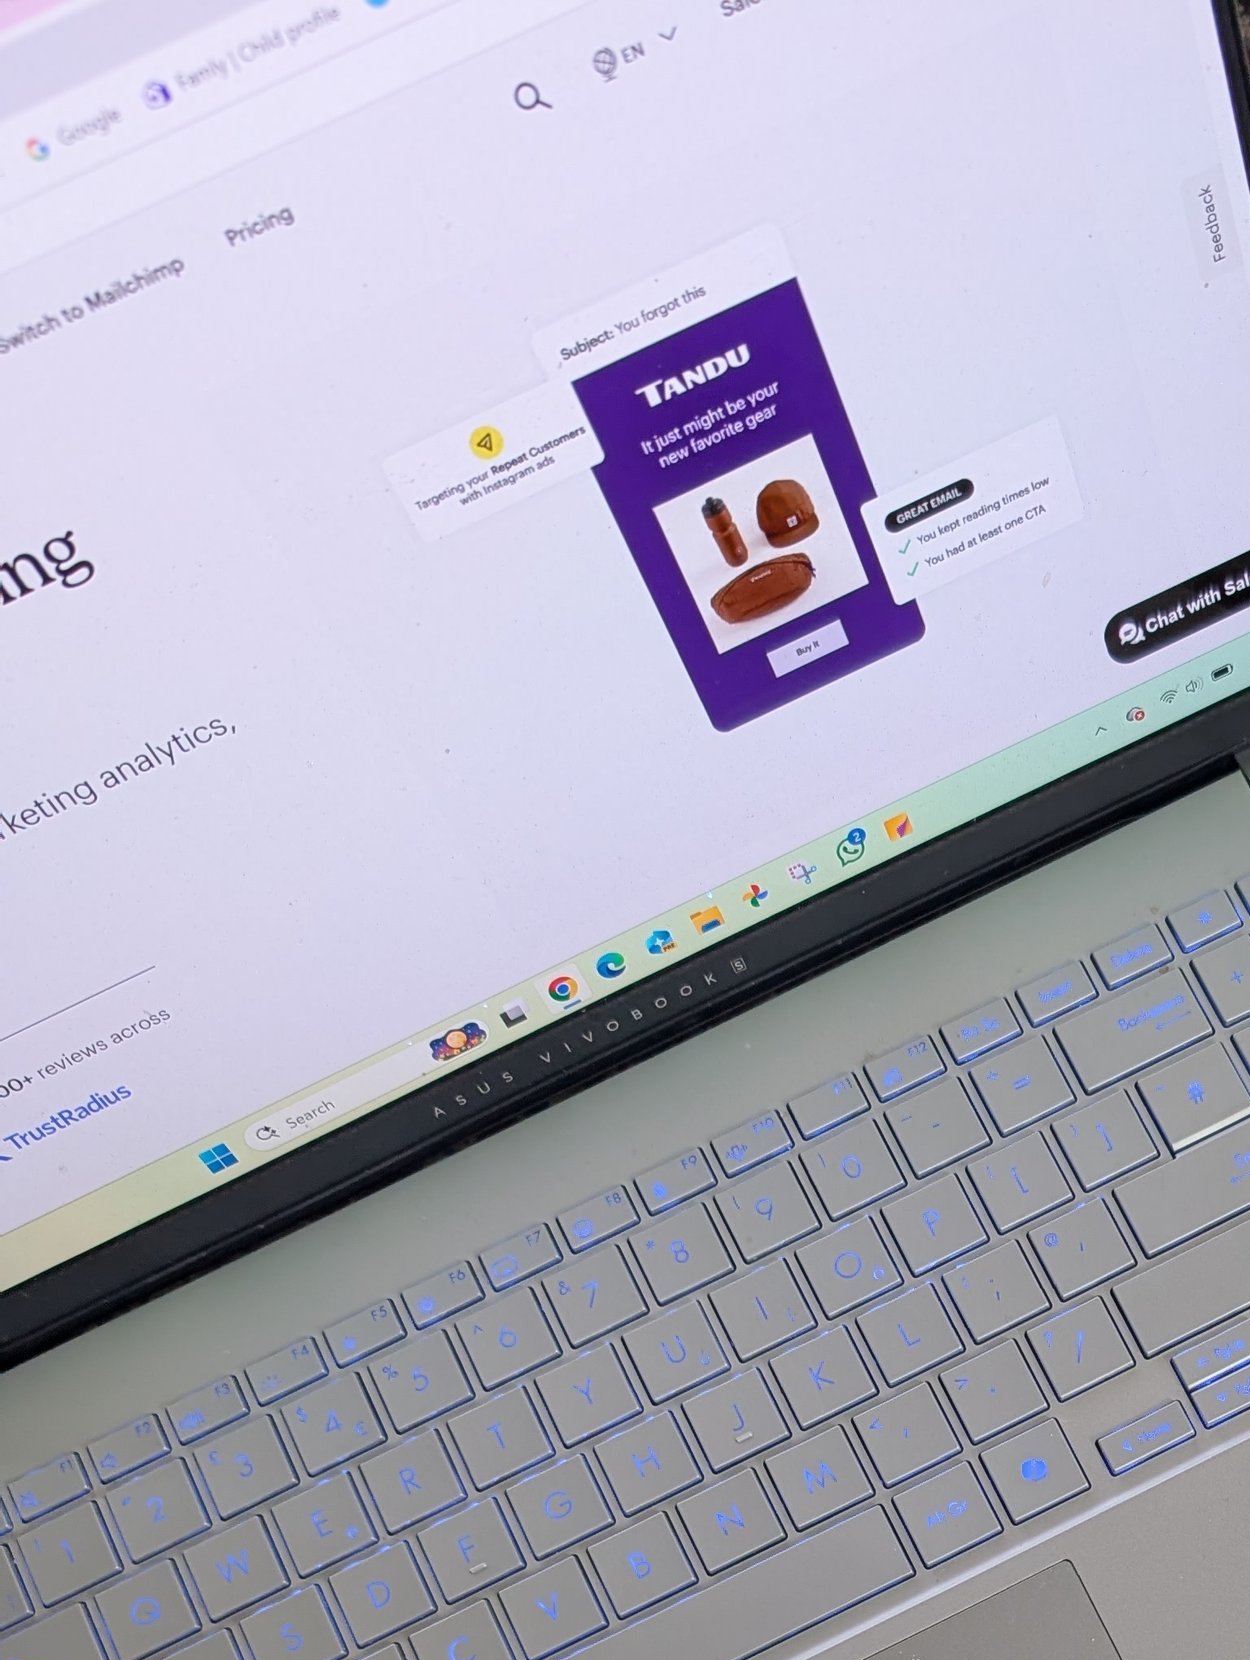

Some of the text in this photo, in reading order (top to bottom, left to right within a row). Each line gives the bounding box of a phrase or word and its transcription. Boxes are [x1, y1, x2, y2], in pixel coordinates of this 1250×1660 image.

[237, 28, 285, 63] Child
[285, 6, 341, 47] profile
[621, 42, 645, 63] EN
[56, 107, 121, 146] Google
[225, 207, 295, 246] Pricing
[1197, 184, 1226, 263] Feedback
[0, 258, 185, 354] Switch to Mailchimp
[560, 285, 706, 361] Subject: You forgot this
[634, 343, 750, 408] TANDU
[641, 381, 779, 455] It just might be your
[658, 404, 777, 468] new favorite gear
[415, 426, 587, 511] Targeting your Repeat Customers
[459, 456, 556, 507] with Instagram ads
[896, 488, 962, 524] GREAT EMAIL
[917, 477, 1050, 546] You kept reading times low
[925, 504, 1046, 568] You had at least one CTA
[1145, 604, 1186, 634] Chat
[1185, 587, 1221, 615] with
[796, 644, 813, 657] Buy
[99, 716, 237, 790] analytics,
[852, 830, 864, 845] 2
[36, 1037, 108, 1080] reviews
[109, 1007, 171, 1045] across
[434, 1072, 513, 1118] ASUS
[540, 973, 717, 1064] VIVOBOOK
[3, 1083, 132, 1152] TrustRadius
[285, 1097, 335, 1130] Search
[681, 1154, 698, 1171] F9
[605, 1192, 622, 1208] F8
[755, 1198, 773, 1221] 9
[921, 1207, 941, 1238] P
[525, 1230, 542, 1247] F7
[669, 1239, 690, 1264] 8
[448, 1269, 466, 1285] F6
[834, 1251, 862, 1280] O
[557, 1280, 571, 1297] &
[581, 1279, 599, 1309] 7
[370, 1305, 387, 1322] F5
[498, 1327, 518, 1349] 6
[660, 1334, 687, 1365] U
[896, 1322, 921, 1347] L
[382, 1364, 399, 1381] %
[412, 1366, 430, 1393] 5
[808, 1359, 836, 1392] K
[571, 1377, 594, 1405] Y
[325, 1409, 343, 1433] 4
[732, 1403, 745, 1432] J
[487, 1421, 507, 1450] T
[234, 1453, 254, 1478] 3
[631, 1445, 663, 1479] H
[398, 1466, 423, 1496] R
[802, 1460, 838, 1496] M
[147, 1494, 166, 1523] 2
[543, 1490, 573, 1520] G
[714, 1503, 746, 1537] N
[310, 1509, 334, 1538] E
[458, 1534, 475, 1564] F
[214, 1548, 249, 1584] W
[626, 1550, 653, 1580] B
[366, 1579, 391, 1610] D
[535, 1590, 558, 1622] V
[279, 1622, 304, 1652] S
